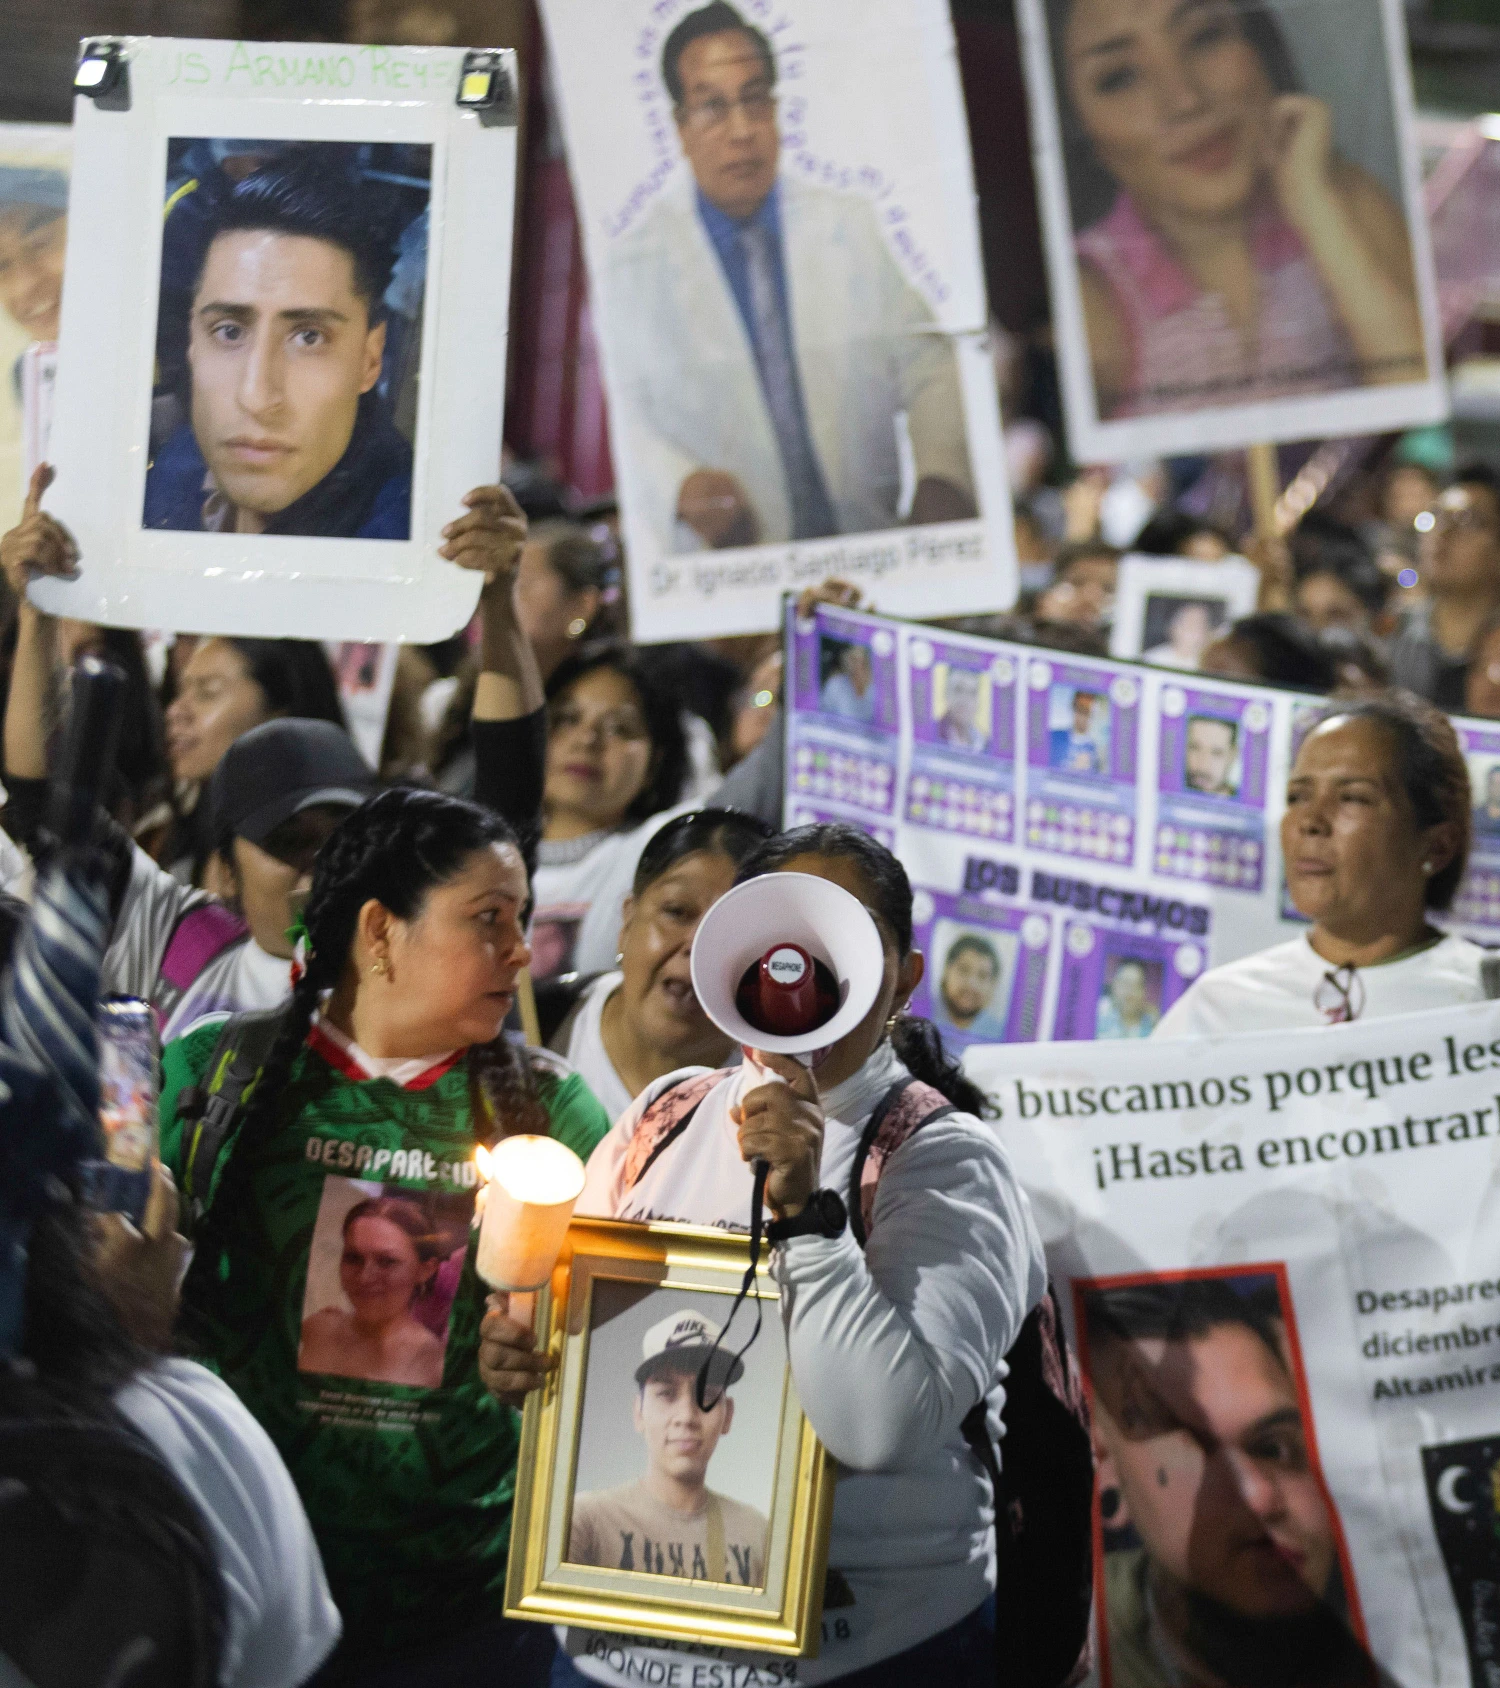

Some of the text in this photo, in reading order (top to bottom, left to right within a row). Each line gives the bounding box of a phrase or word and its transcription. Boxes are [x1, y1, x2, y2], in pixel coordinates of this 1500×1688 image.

[963, 855, 1020, 896] LOS
[1031, 869, 1210, 936] BUSCAMOS
[1015, 1074, 1251, 1119] buscamos
[1264, 1050, 1432, 1111] porque
[1094, 1139, 1245, 1189] ¡Hasta
